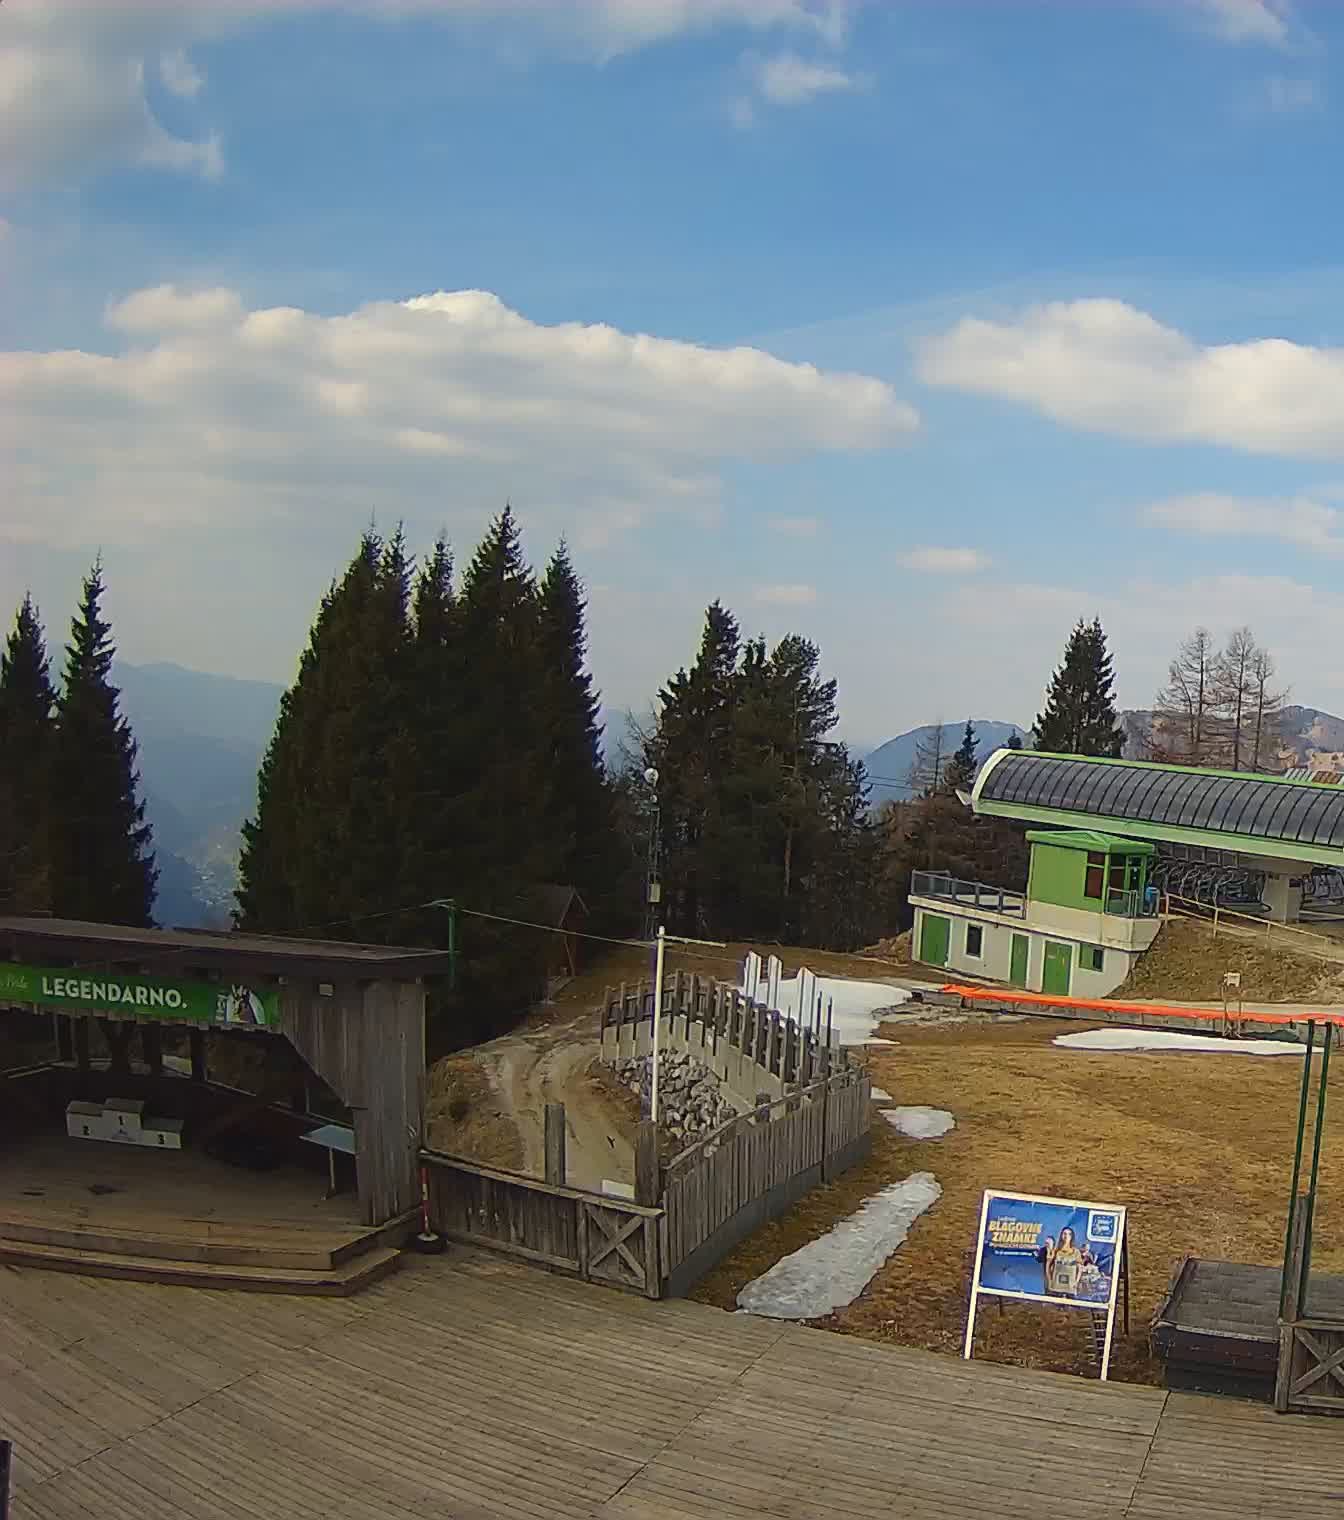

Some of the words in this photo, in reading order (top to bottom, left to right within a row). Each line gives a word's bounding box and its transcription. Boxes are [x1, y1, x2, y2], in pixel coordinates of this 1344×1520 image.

[41, 976, 188, 1009] LEGENDARNO.
[83, 1125, 90, 1136] 2
[158, 1133, 165, 1145] 3
